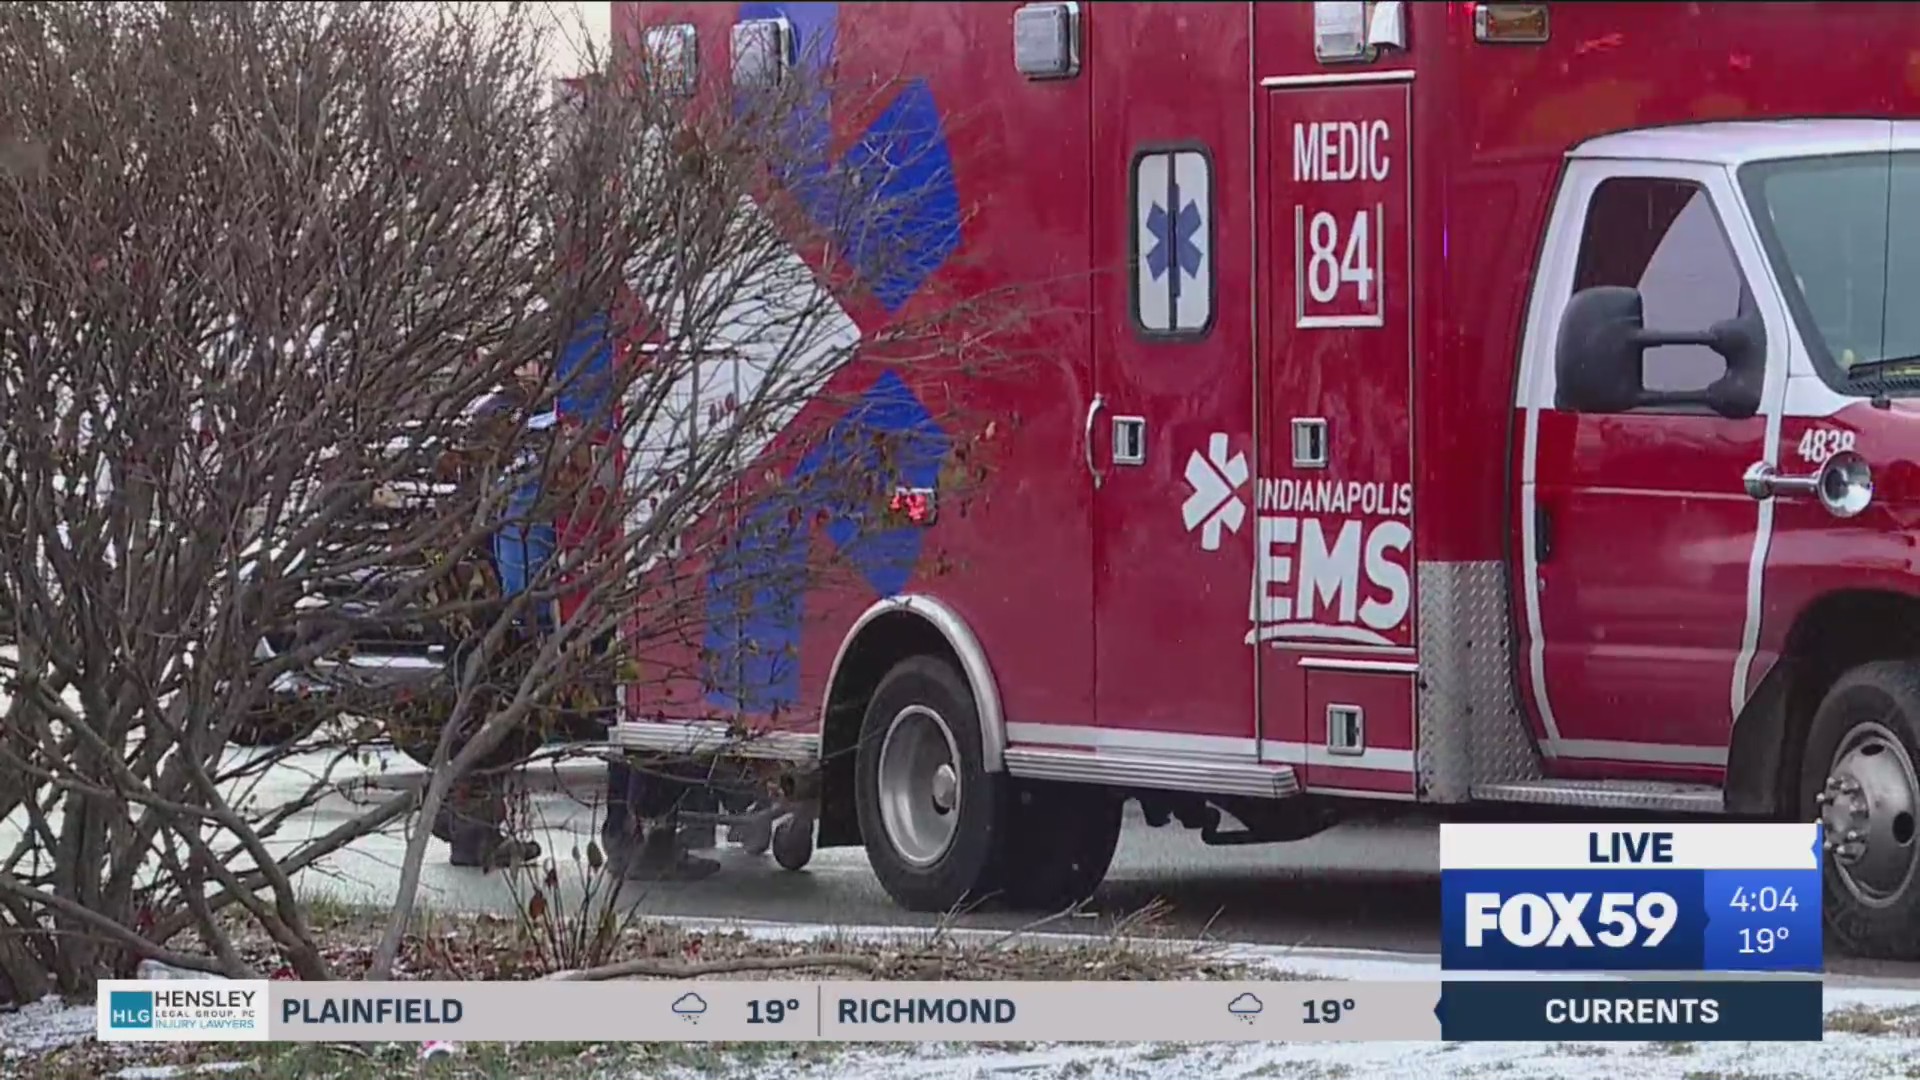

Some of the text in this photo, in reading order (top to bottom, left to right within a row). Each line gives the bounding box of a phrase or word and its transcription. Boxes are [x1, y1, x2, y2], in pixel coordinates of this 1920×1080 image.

[1294, 119, 1389, 181] MEDIC
[1308, 210, 1373, 303] 84
[1257, 478, 1412, 516] INDIANAPOLIS
[1249, 516, 1412, 630] EMS
